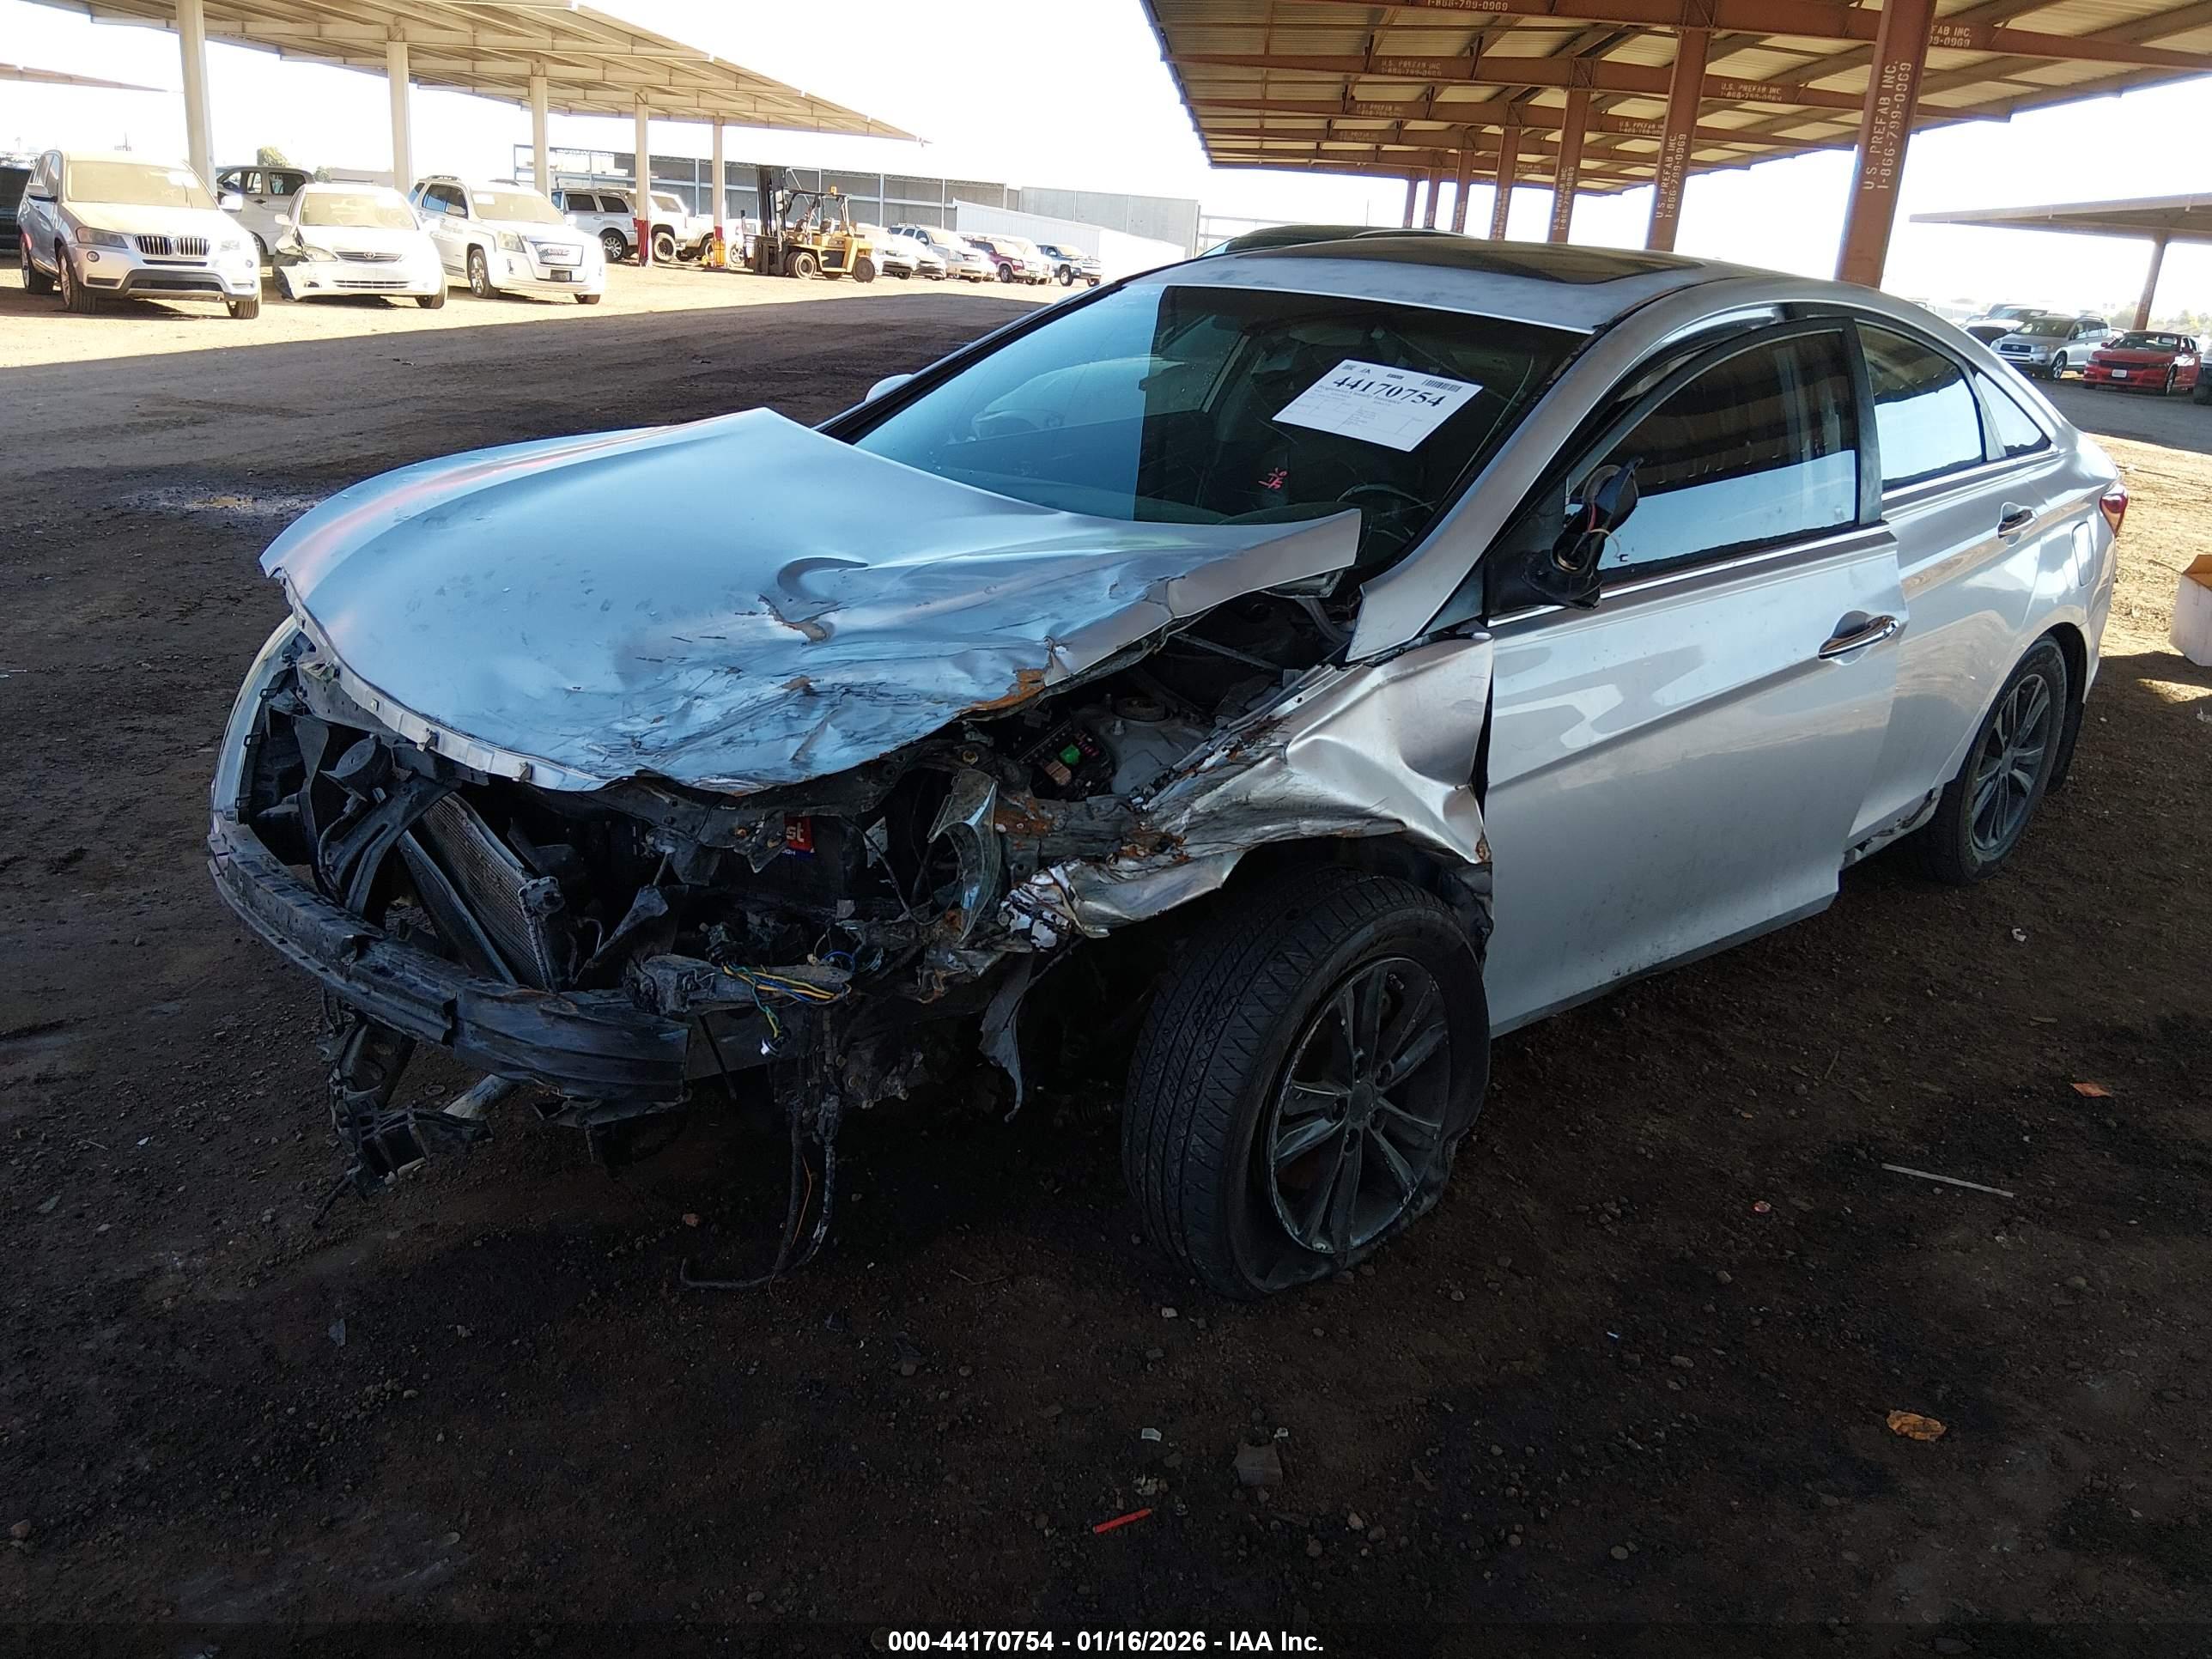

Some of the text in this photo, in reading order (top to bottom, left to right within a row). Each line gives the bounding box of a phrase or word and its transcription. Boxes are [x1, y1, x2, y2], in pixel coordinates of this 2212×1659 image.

[1869, 96, 1891, 154] PREFAB
[1881, 61, 1899, 88] INC.
[1877, 62, 1912, 189] 1-866-799-0969
[1660, 156, 1674, 194] PREFAB
[1665, 133, 1687, 218] 1-866-799-0969
[1333, 376, 1446, 407] 44170754
